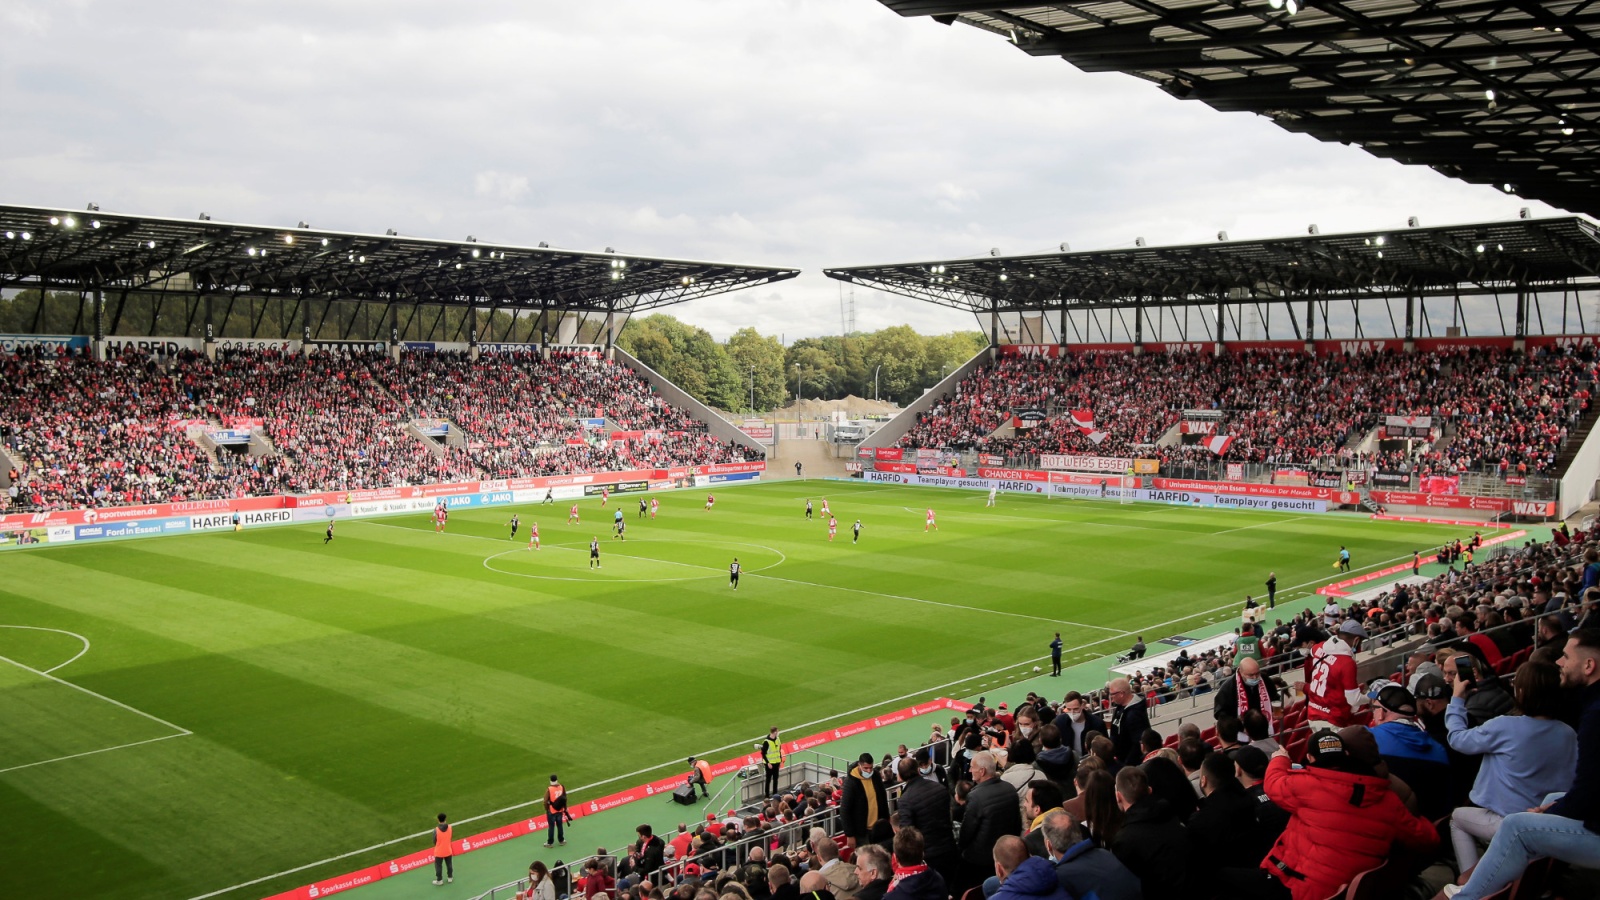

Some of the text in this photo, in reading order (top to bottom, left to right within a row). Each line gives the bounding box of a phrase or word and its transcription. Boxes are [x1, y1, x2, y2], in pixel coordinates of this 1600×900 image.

[1018, 346, 1050, 360] WAZ
[846, 463, 862, 473] WAZ
[1098, 458, 1131, 471] ESSEN
[984, 470, 1022, 479] CHANCEN
[918, 476, 956, 486] Teamplayer
[958, 480, 989, 488] gesucht!
[1229, 485, 1246, 493] Essen
[171, 500, 230, 511] COLLECTION
[450, 496, 471, 506] JAKO
[1214, 495, 1268, 507] Teamplayer
[1271, 501, 1315, 511] gesucht!
[99, 508, 157, 520] sportwetten.de
[1513, 502, 1546, 515] WAZ
[106, 525, 161, 537] Ford in Essen!
[841, 725, 867, 737] Sparkasse Essen
[799, 737, 826, 750] Sparkasse Essen
[726, 764, 738, 772] Essen
[655, 781, 675, 793] Sparkasse
[599, 796, 635, 811] Sparkasse Essen
[472, 831, 514, 849] Sparkasse Essen
[400, 856, 427, 871] Sparkasse
[321, 875, 372, 896] Sparkasse Essen
